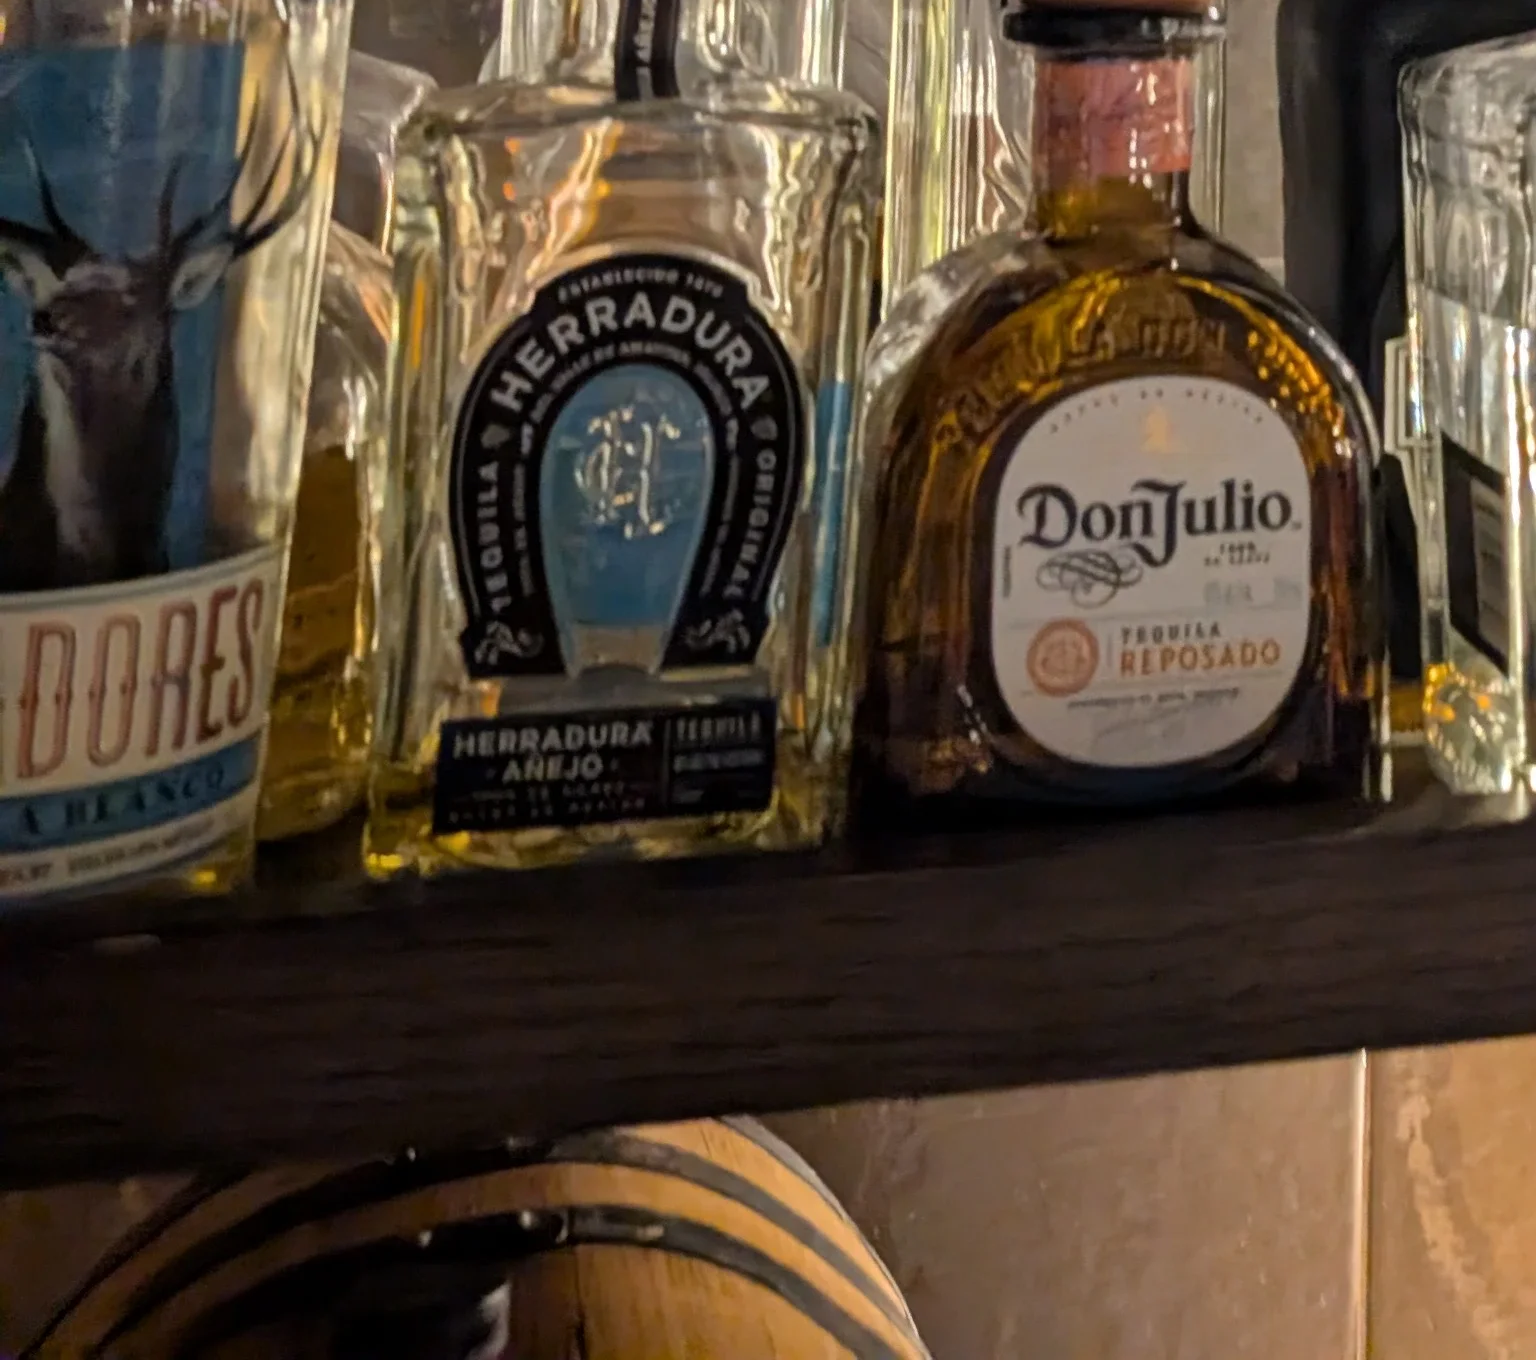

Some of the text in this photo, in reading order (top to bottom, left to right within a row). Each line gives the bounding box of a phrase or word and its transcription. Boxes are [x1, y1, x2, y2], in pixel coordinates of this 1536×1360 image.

[490, 290, 771, 413] HERRADURA
[477, 460, 512, 614] TEQUILA
[722, 447, 778, 598] ORIGINAL
[1119, 636, 1282, 677] REPOSADO
[1120, 621, 1222, 645] TEQUILA
[15, 577, 265, 780] DORES
[452, 719, 654, 760] HERRADURA
[501, 748, 604, 783] AÑEJO
